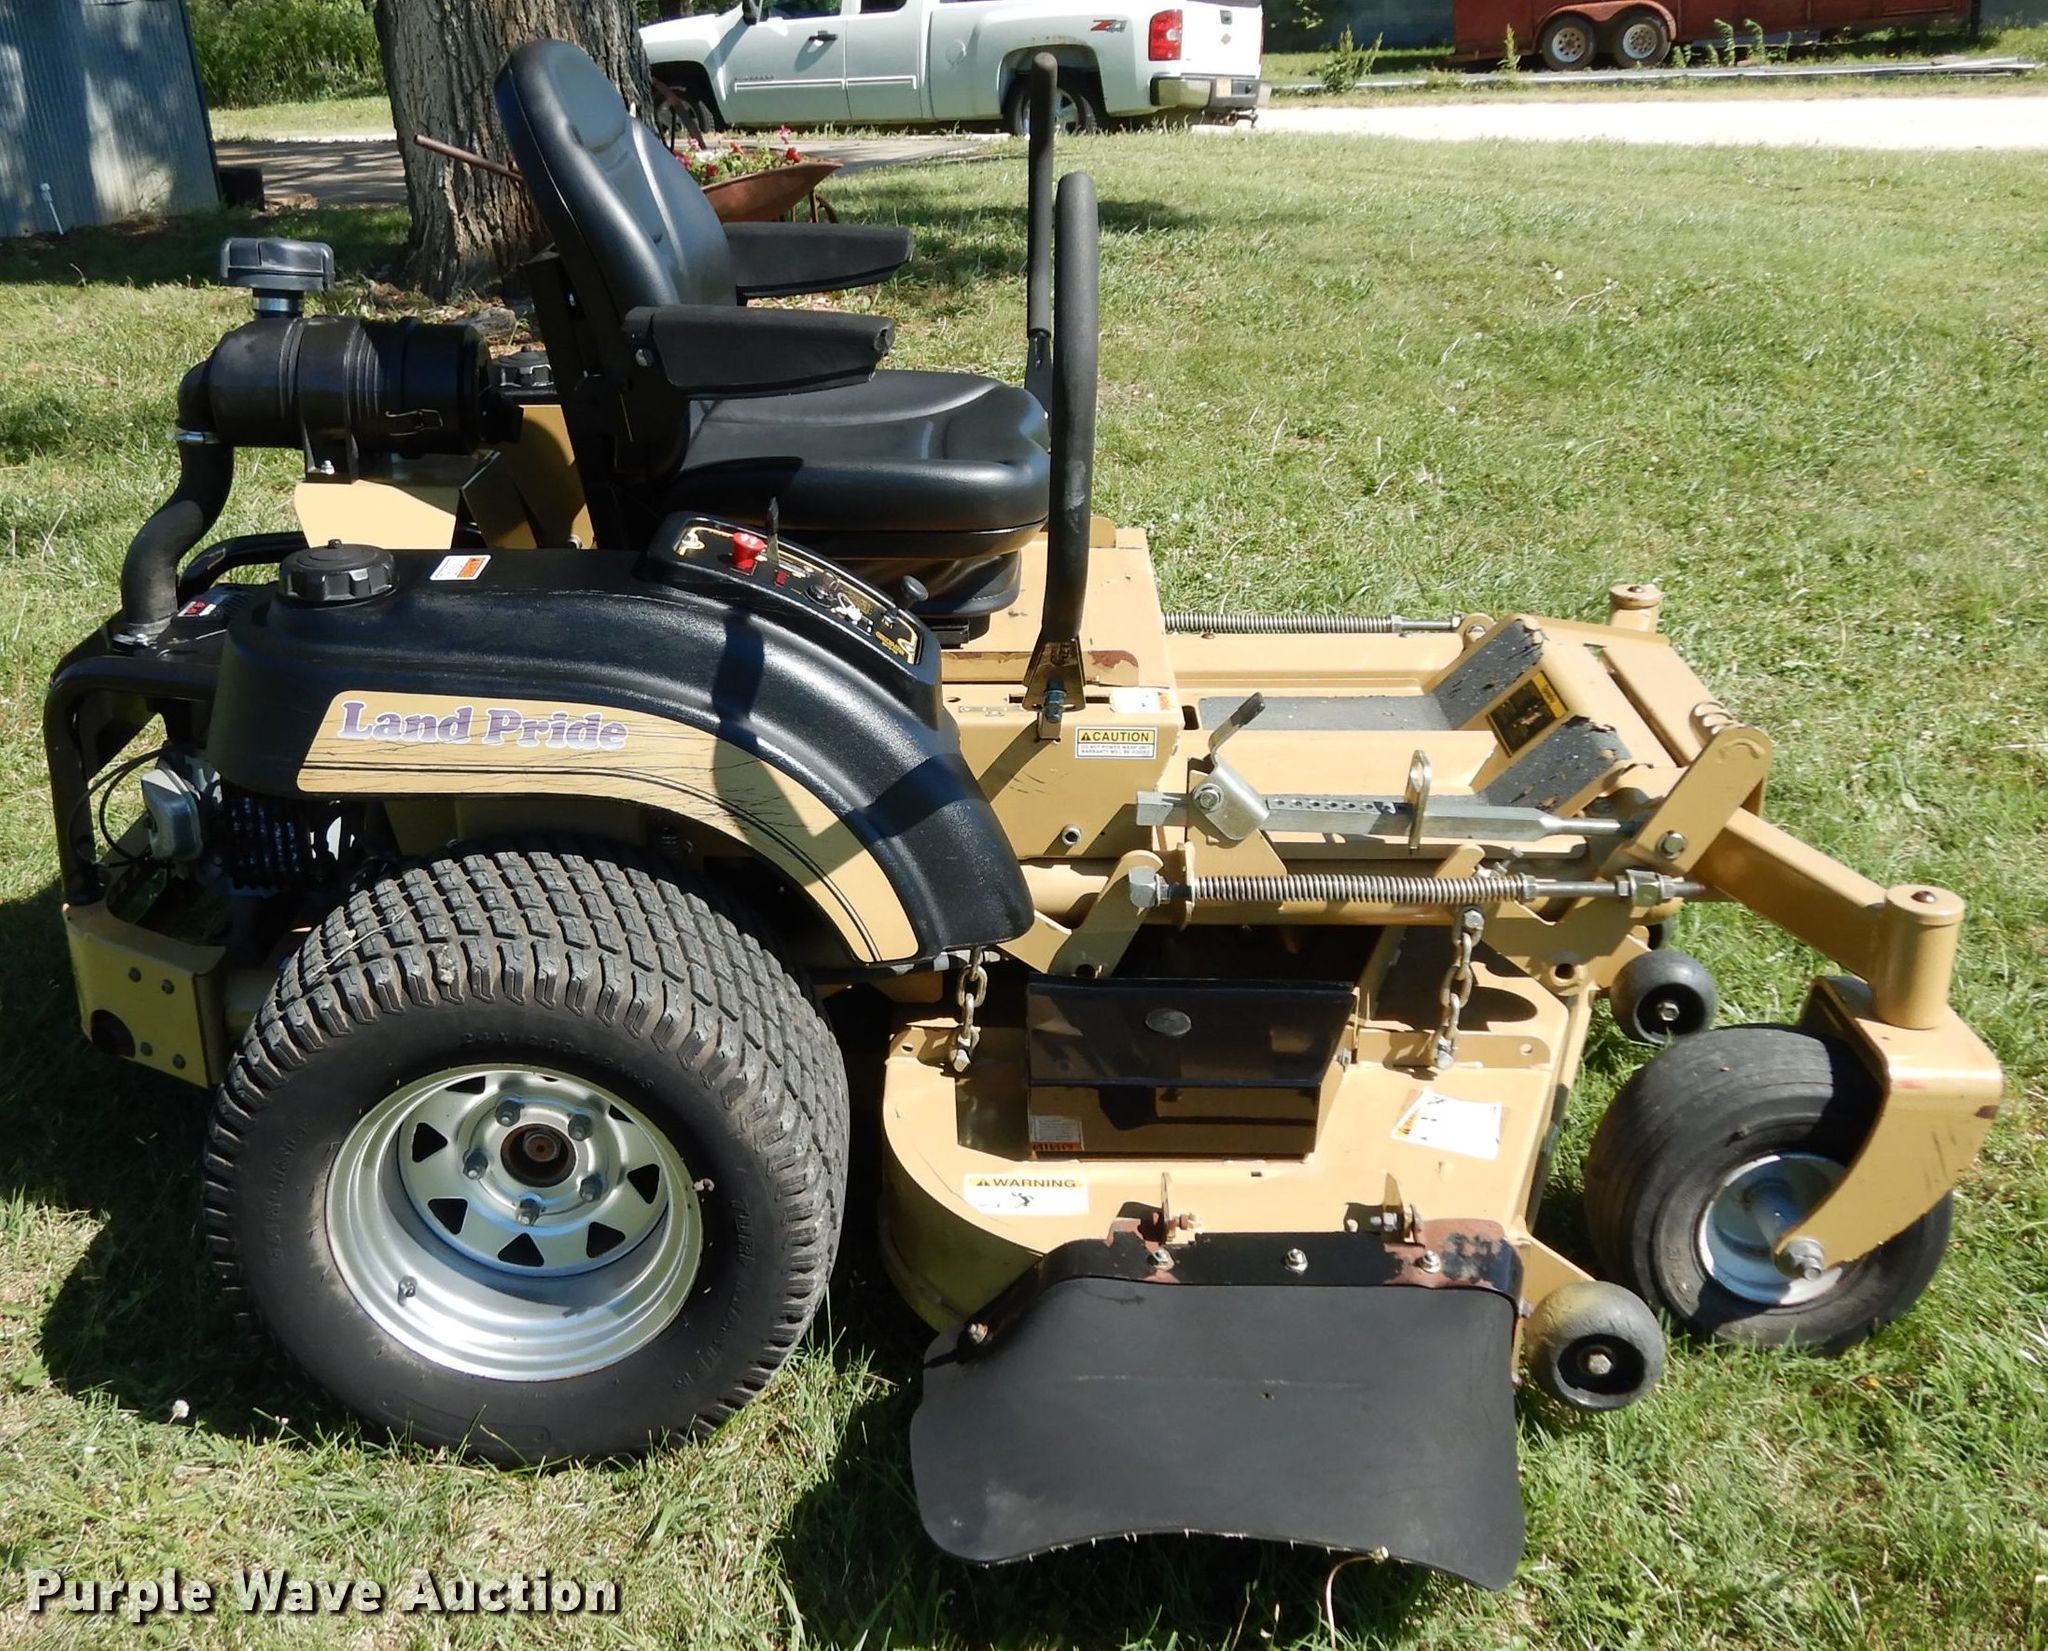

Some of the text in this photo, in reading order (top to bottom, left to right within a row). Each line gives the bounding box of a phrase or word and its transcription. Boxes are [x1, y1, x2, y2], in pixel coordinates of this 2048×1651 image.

[337, 700, 628, 750] Land Pride
[1093, 731, 1149, 742] CAUTION
[993, 1178, 1076, 1188] WARNING
